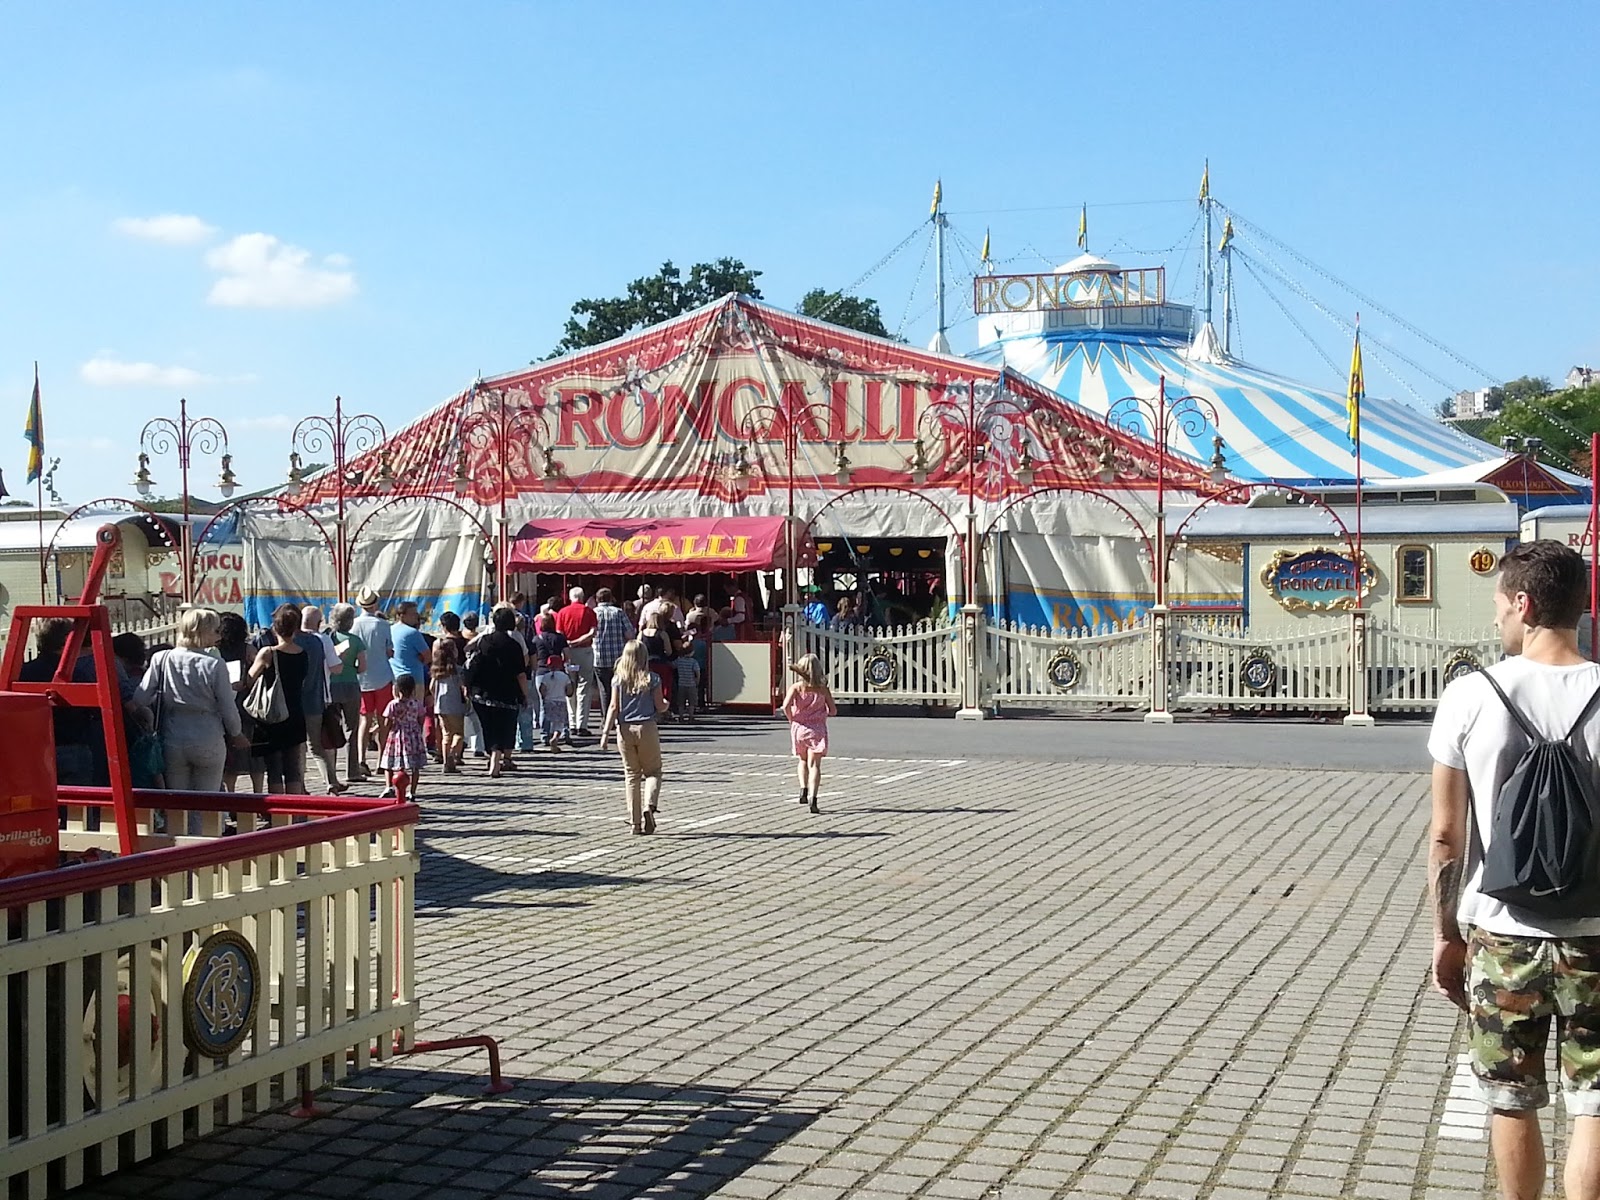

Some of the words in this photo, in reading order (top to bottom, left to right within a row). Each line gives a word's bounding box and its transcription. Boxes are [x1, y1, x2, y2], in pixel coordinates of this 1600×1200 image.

[978, 269, 1162, 312] RONCALLI
[554, 376, 918, 449] RONCALLI
[531, 534, 753, 562] RONCALLI
[1289, 560, 1348, 575] CIRCUS
[1472, 553, 1491, 569] 19
[29, 836, 52, 847] 600
